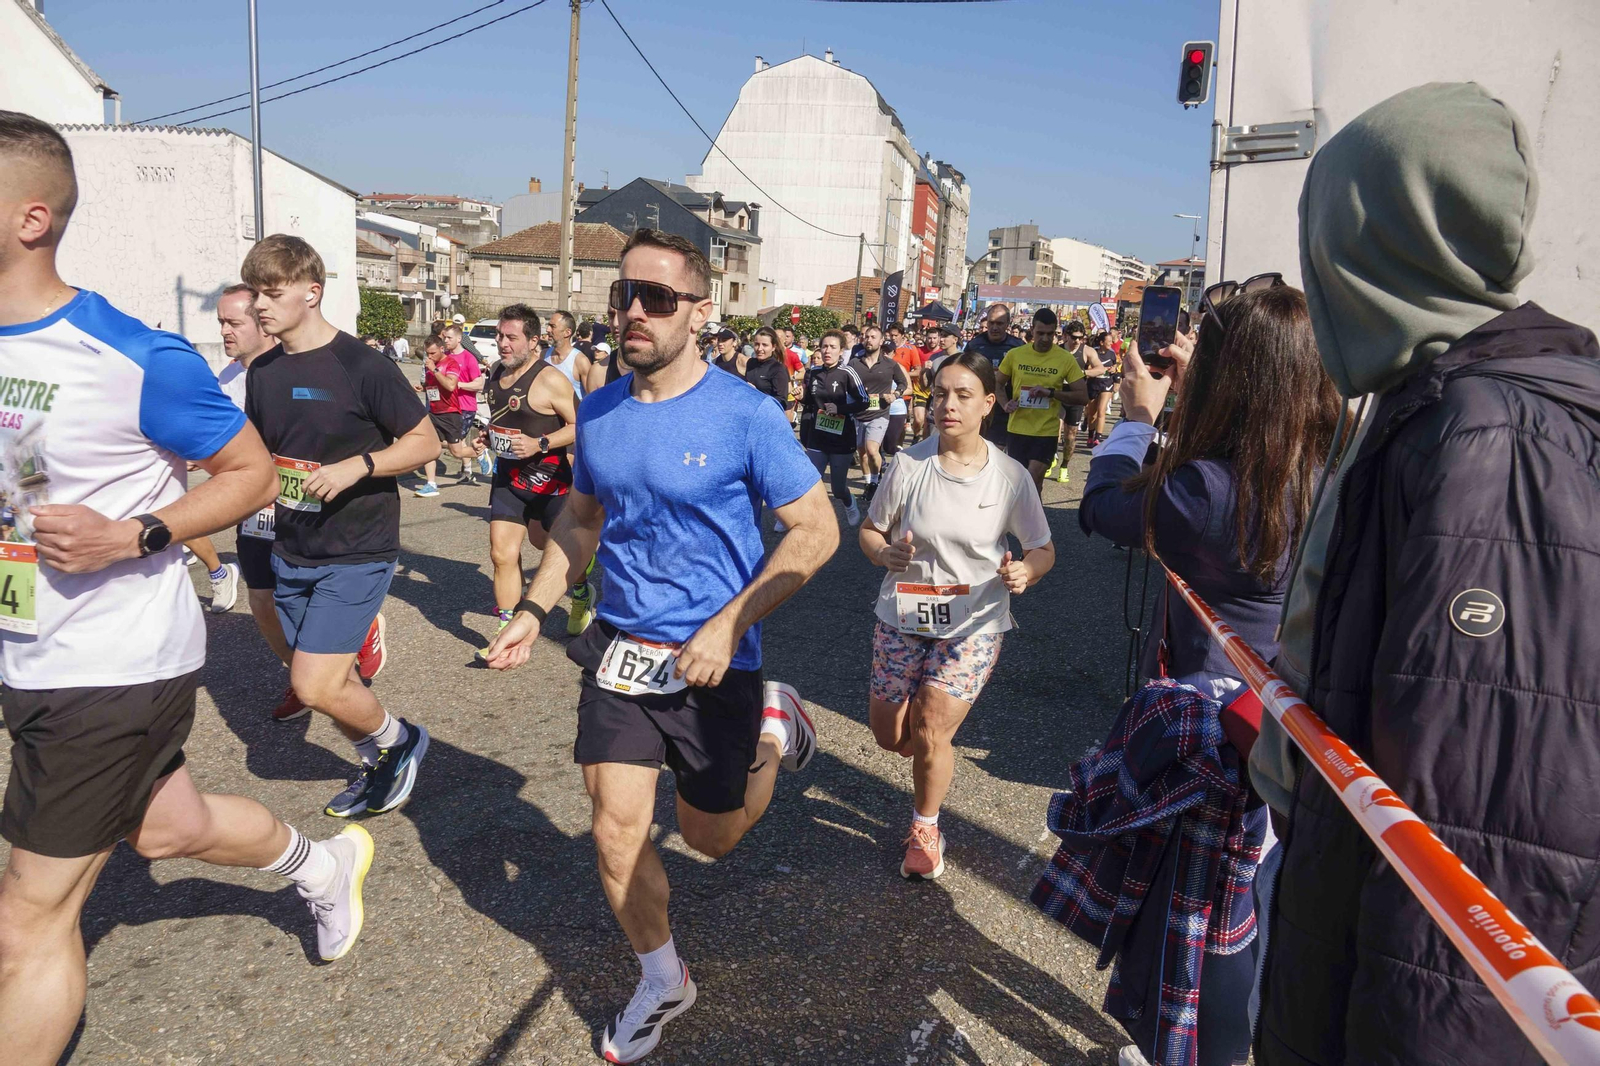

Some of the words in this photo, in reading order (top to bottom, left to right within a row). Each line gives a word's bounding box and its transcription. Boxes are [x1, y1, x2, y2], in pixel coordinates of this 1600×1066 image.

[1047, 367, 1058, 375] 3D
[819, 417, 841, 430] 2097
[917, 602, 951, 624] 519
[618, 649, 669, 688] 624
[1324, 748, 1355, 778] oporriño
[1467, 904, 1527, 960] oporriño
